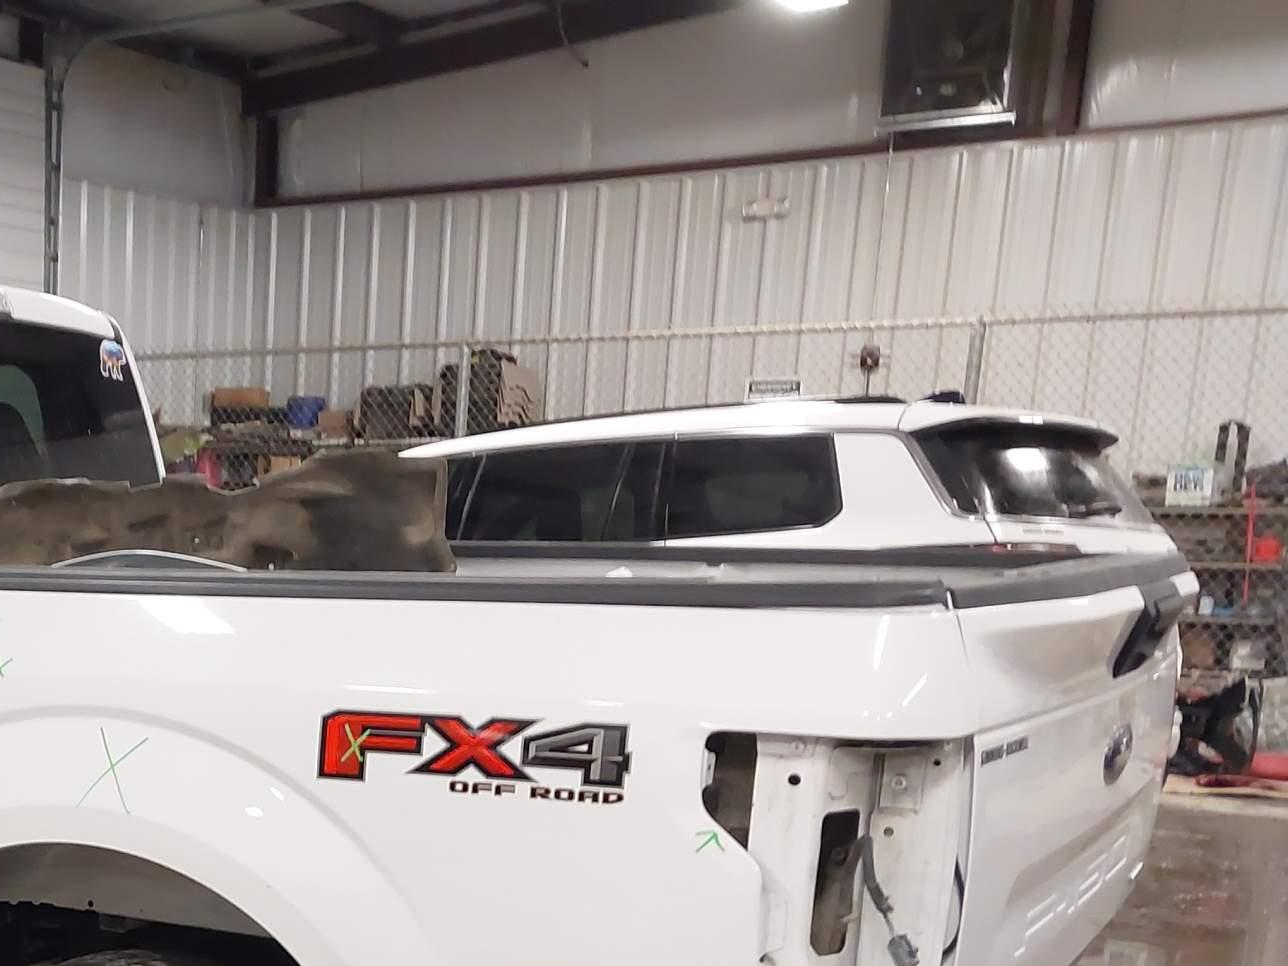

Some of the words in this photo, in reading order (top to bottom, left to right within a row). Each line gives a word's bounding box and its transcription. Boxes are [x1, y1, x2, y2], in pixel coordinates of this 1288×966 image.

[317, 709, 632, 788] FX4
[449, 780, 517, 796] OFF
[529, 785, 624, 804] ROAD
